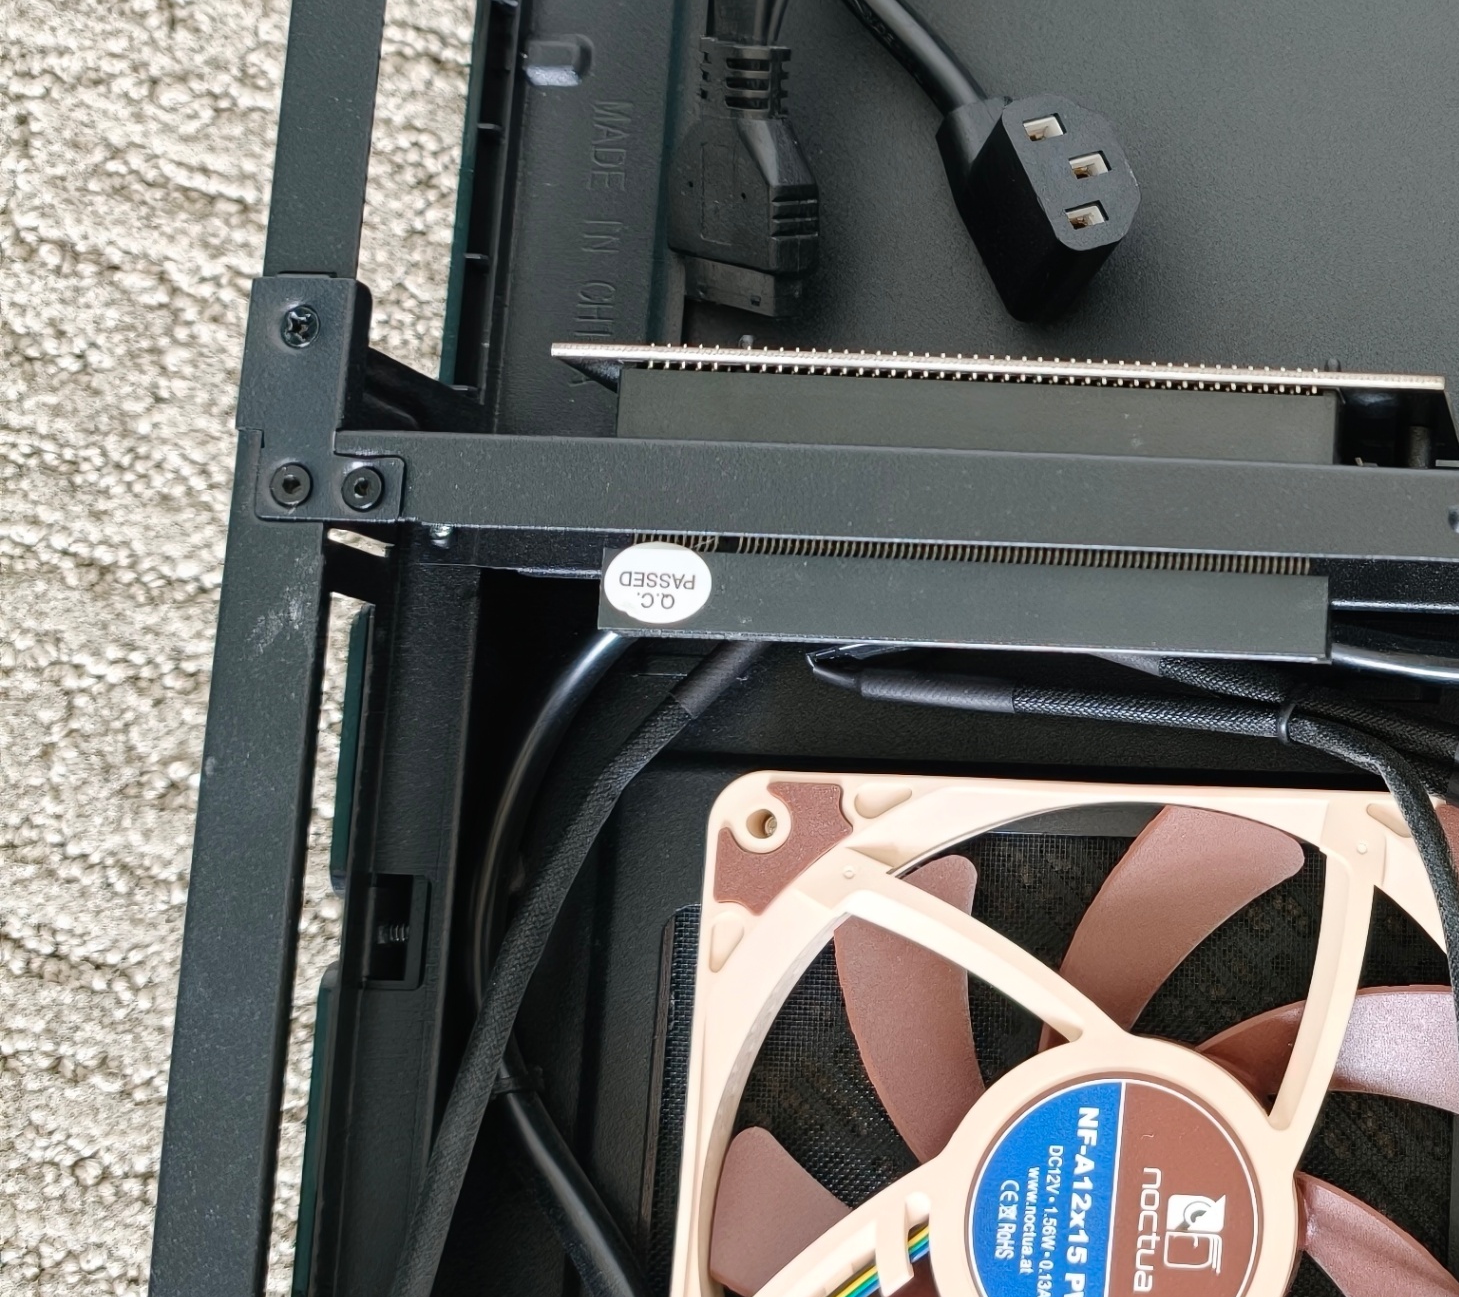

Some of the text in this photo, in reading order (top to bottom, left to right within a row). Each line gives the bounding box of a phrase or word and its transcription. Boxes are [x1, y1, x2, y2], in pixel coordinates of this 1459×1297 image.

[567, 100, 633, 388] MADE IN CHIA
[619, 570, 696, 590] PASSED
[637, 592, 675, 610] Q.C.
[1046, 1145, 1063, 1194] DC12V
[1066, 1107, 1100, 1264] NF-A12x15
[995, 1223, 1016, 1259] RoHS
[1020, 1167, 1040, 1274] www.noctua.at
[1041, 1206, 1059, 1249] 1.56W
[1133, 1167, 1163, 1293] noctua
